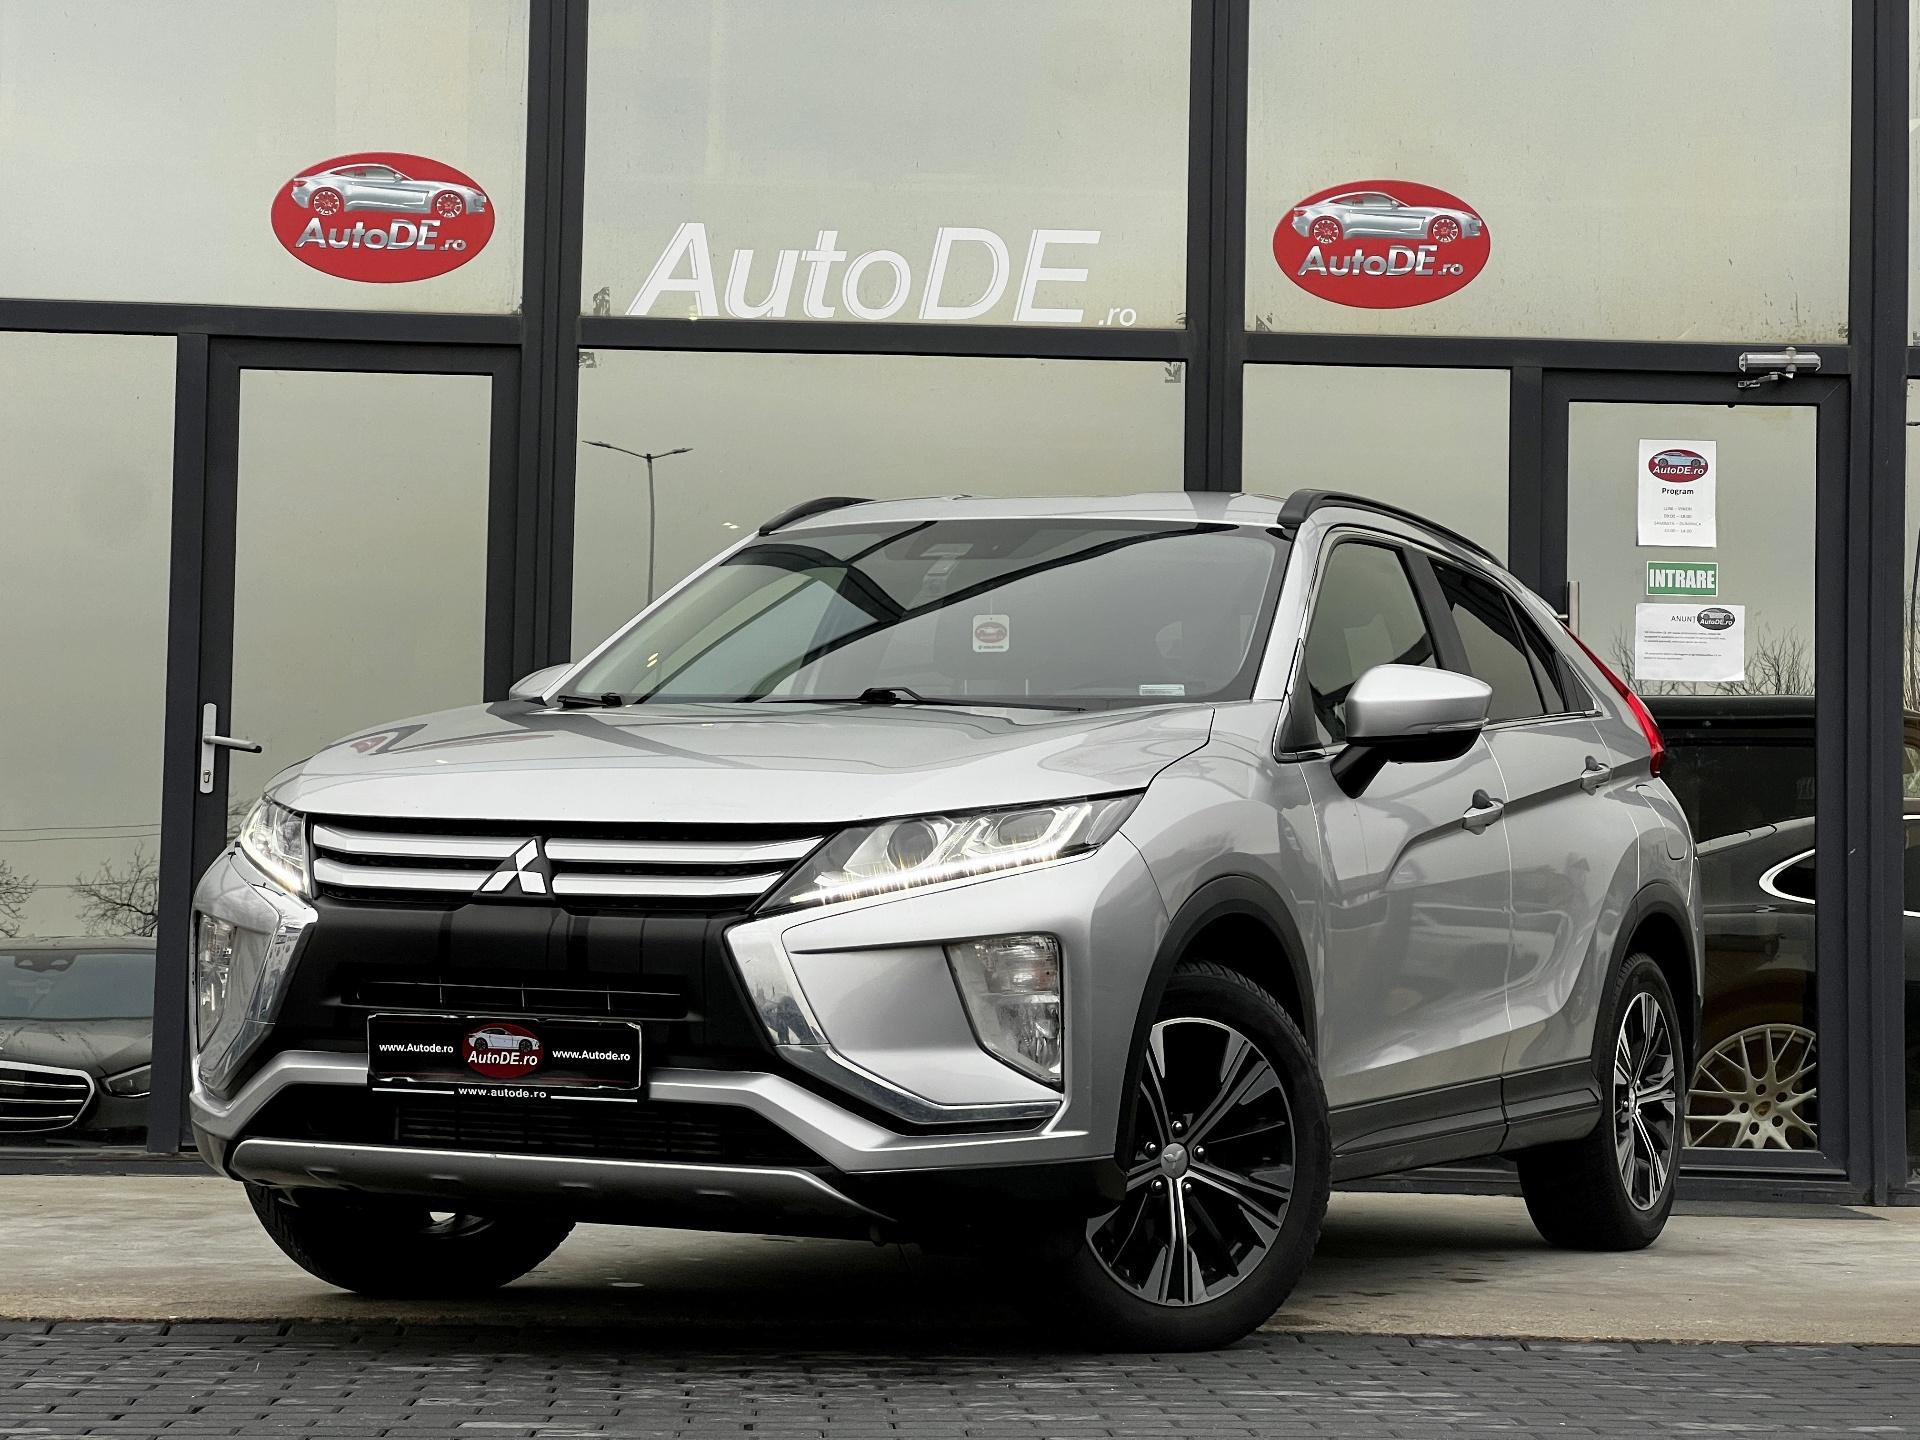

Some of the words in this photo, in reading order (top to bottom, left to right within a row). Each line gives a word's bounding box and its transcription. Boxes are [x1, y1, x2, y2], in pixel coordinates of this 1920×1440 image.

[1652, 465, 1704, 475] AutoDE.ro
[1661, 487, 1694, 495] Program
[1649, 569, 1715, 589] INTRARE
[379, 1042, 454, 1053] www.Autode.ro
[467, 1050, 538, 1066] AutoDE.ro
[552, 1049, 631, 1061] www.Autode.ro
[458, 1086, 547, 1099] www.autode.ro
